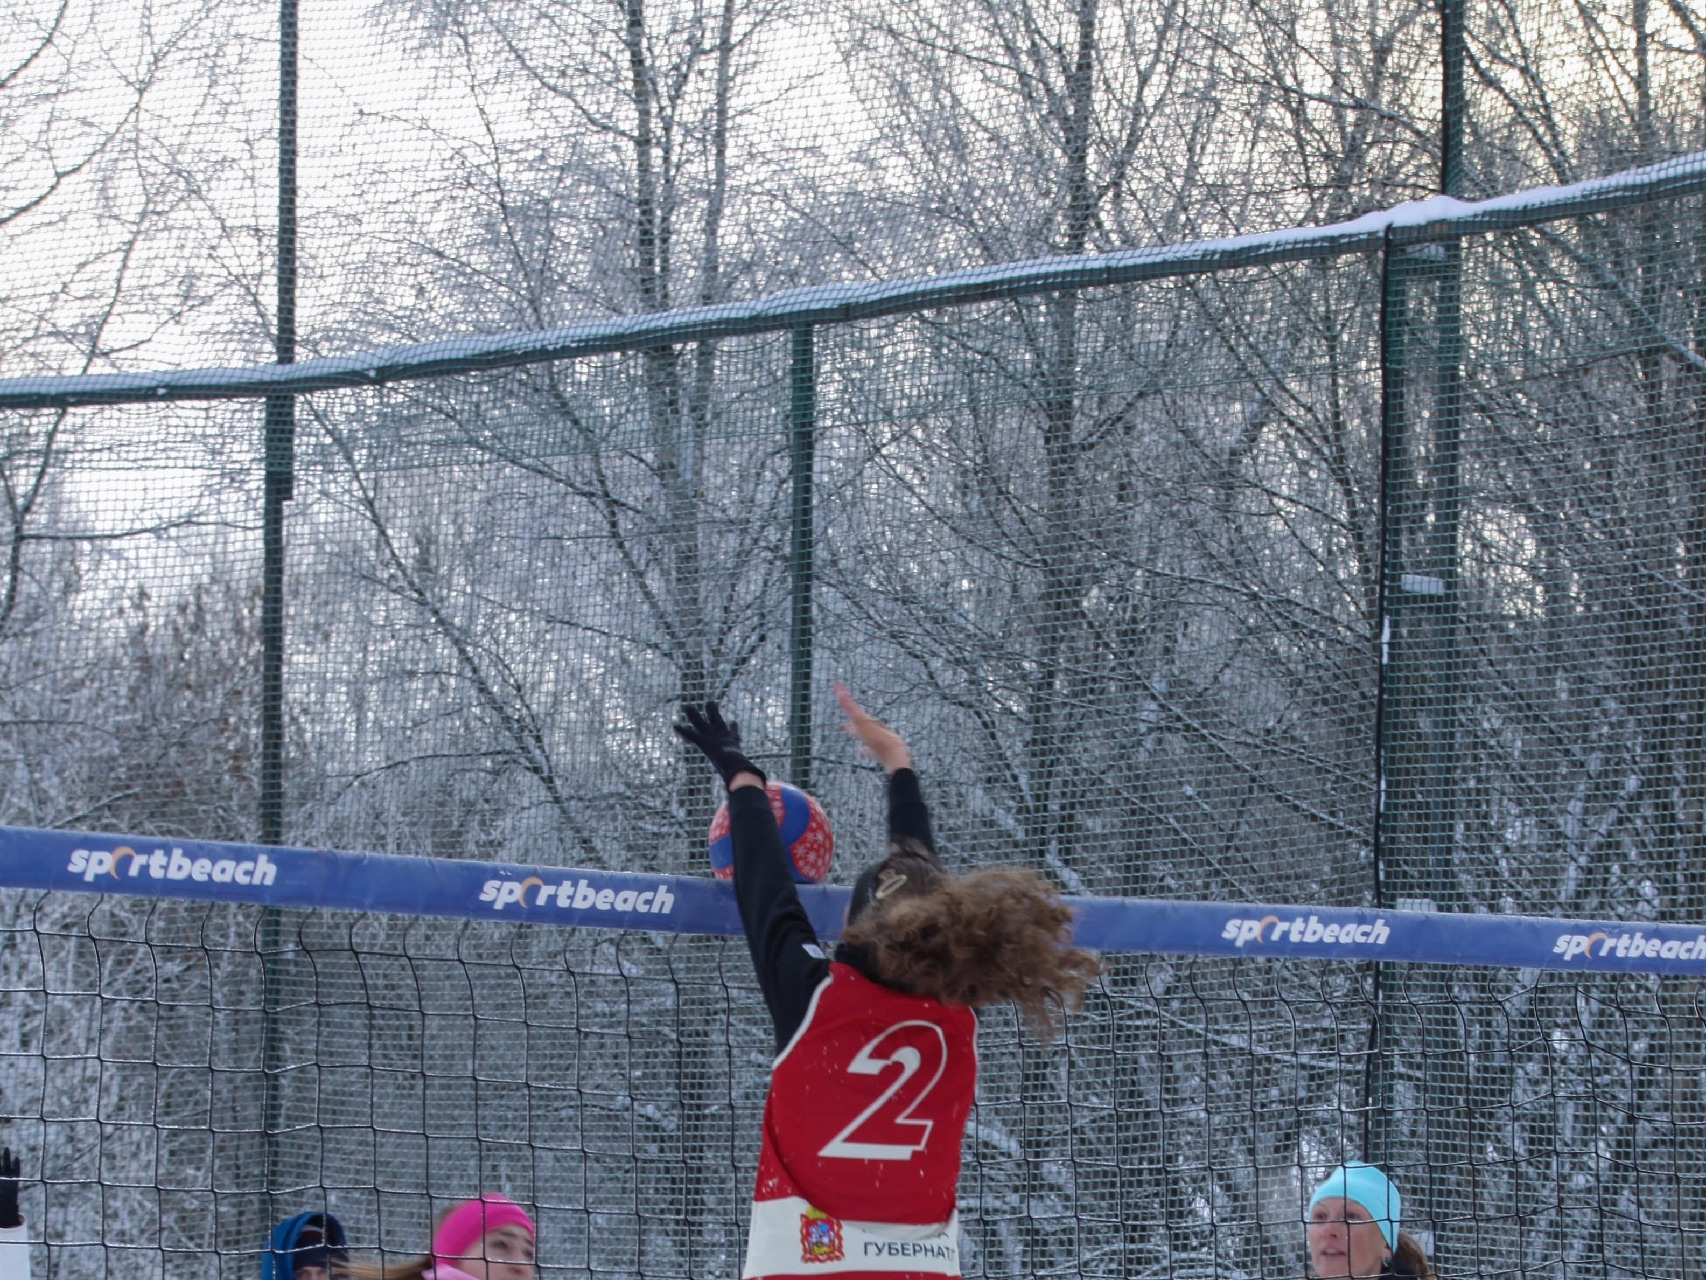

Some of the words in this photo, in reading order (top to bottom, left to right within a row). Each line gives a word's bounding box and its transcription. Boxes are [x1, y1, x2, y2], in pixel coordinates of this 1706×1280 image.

[67, 846, 278, 886] sportbeach
[479, 876, 675, 914] sportbeach
[1221, 915, 1391, 947] sportbeach
[1552, 932, 1706, 960] sportbeach
[818, 1019, 947, 1160] 2
[863, 1242, 955, 1259] ГУБЕРНАТ
